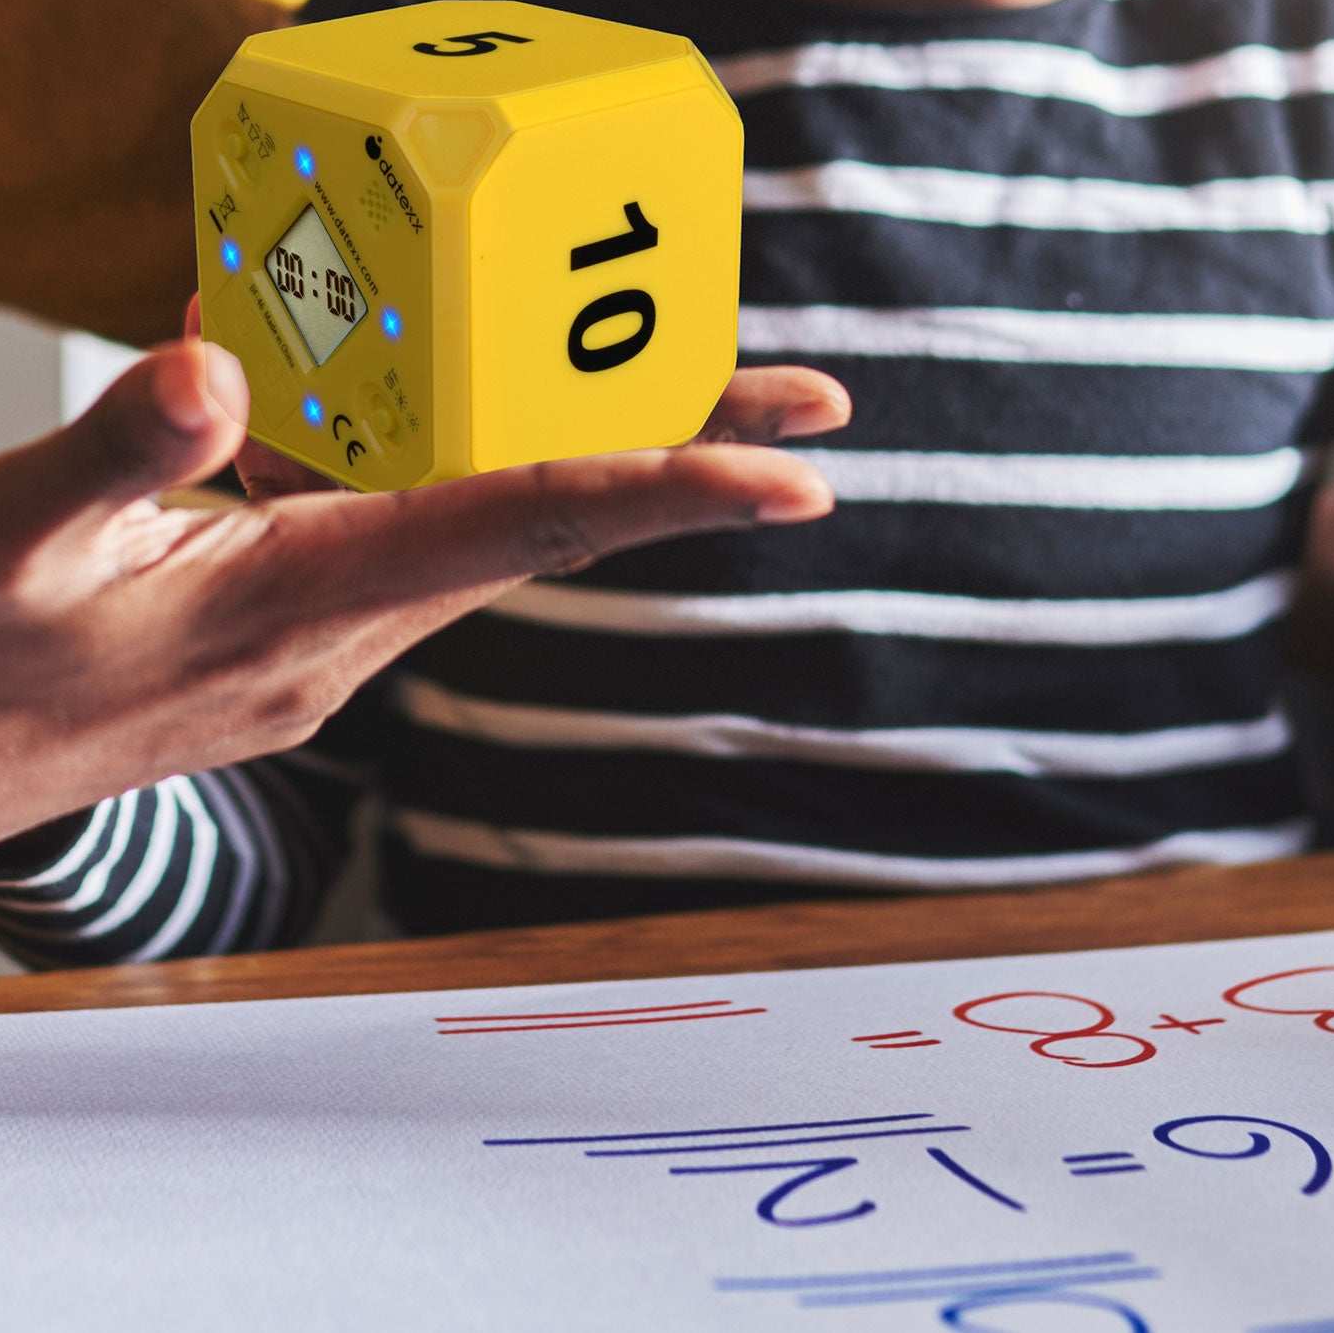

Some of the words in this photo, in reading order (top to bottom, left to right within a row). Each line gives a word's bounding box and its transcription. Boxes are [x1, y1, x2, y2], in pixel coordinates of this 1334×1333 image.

[412, 30, 535, 58] 5
[314, 180, 379, 297] www.datexx.com
[379, 159, 424, 235] datexx
[567, 200, 659, 374] 10
